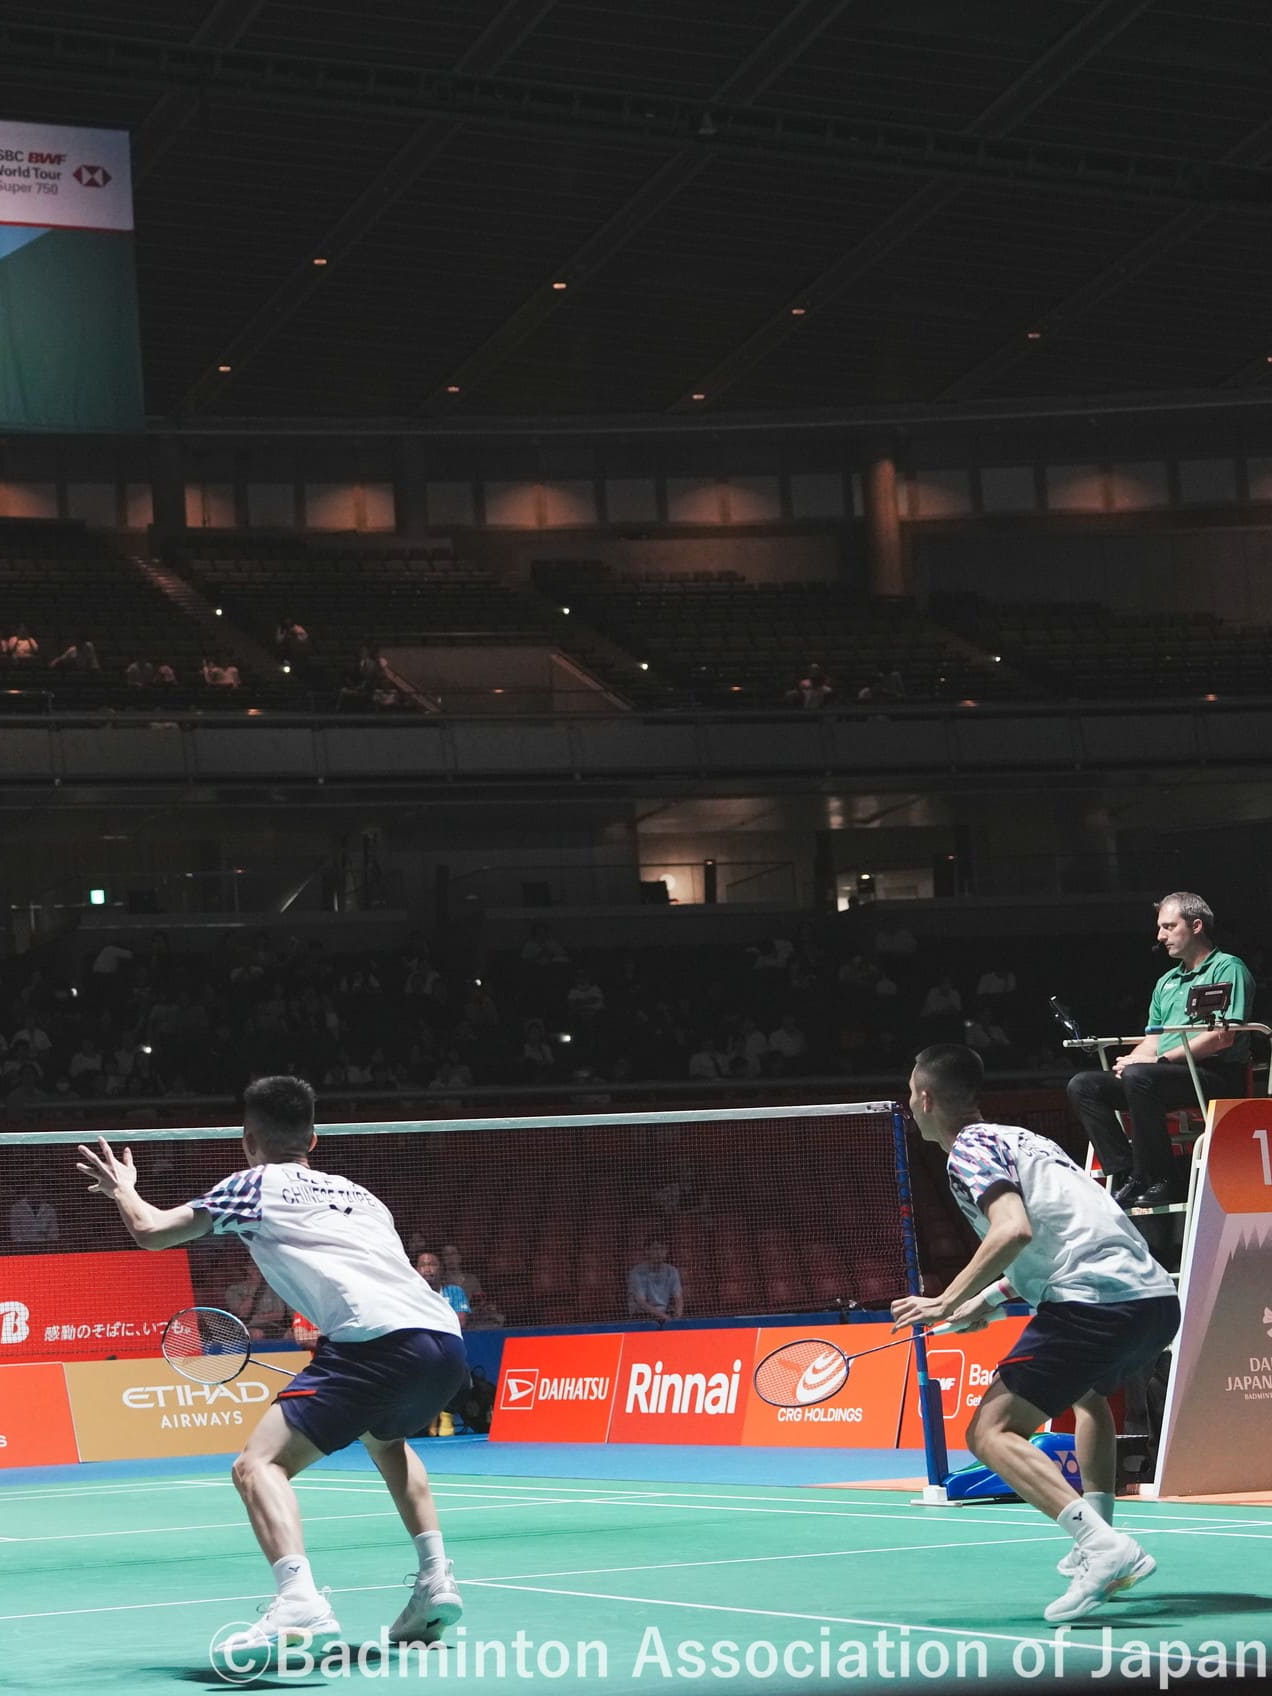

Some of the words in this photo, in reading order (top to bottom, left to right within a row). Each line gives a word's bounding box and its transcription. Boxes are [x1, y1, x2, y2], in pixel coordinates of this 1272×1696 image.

[28, 152, 67, 165] BWF
[34, 167, 62, 180] Tour
[36, 184, 59, 196] 750
[122, 1381, 270, 1409] ETIHAD
[538, 1377, 610, 1401] DAIHATSU
[625, 1360, 742, 1415] Rinnai
[160, 1411, 244, 1430] AIRWAYS
[777, 1407, 804, 1423] CRG
[804, 1408, 863, 1424] HOLDINGS
